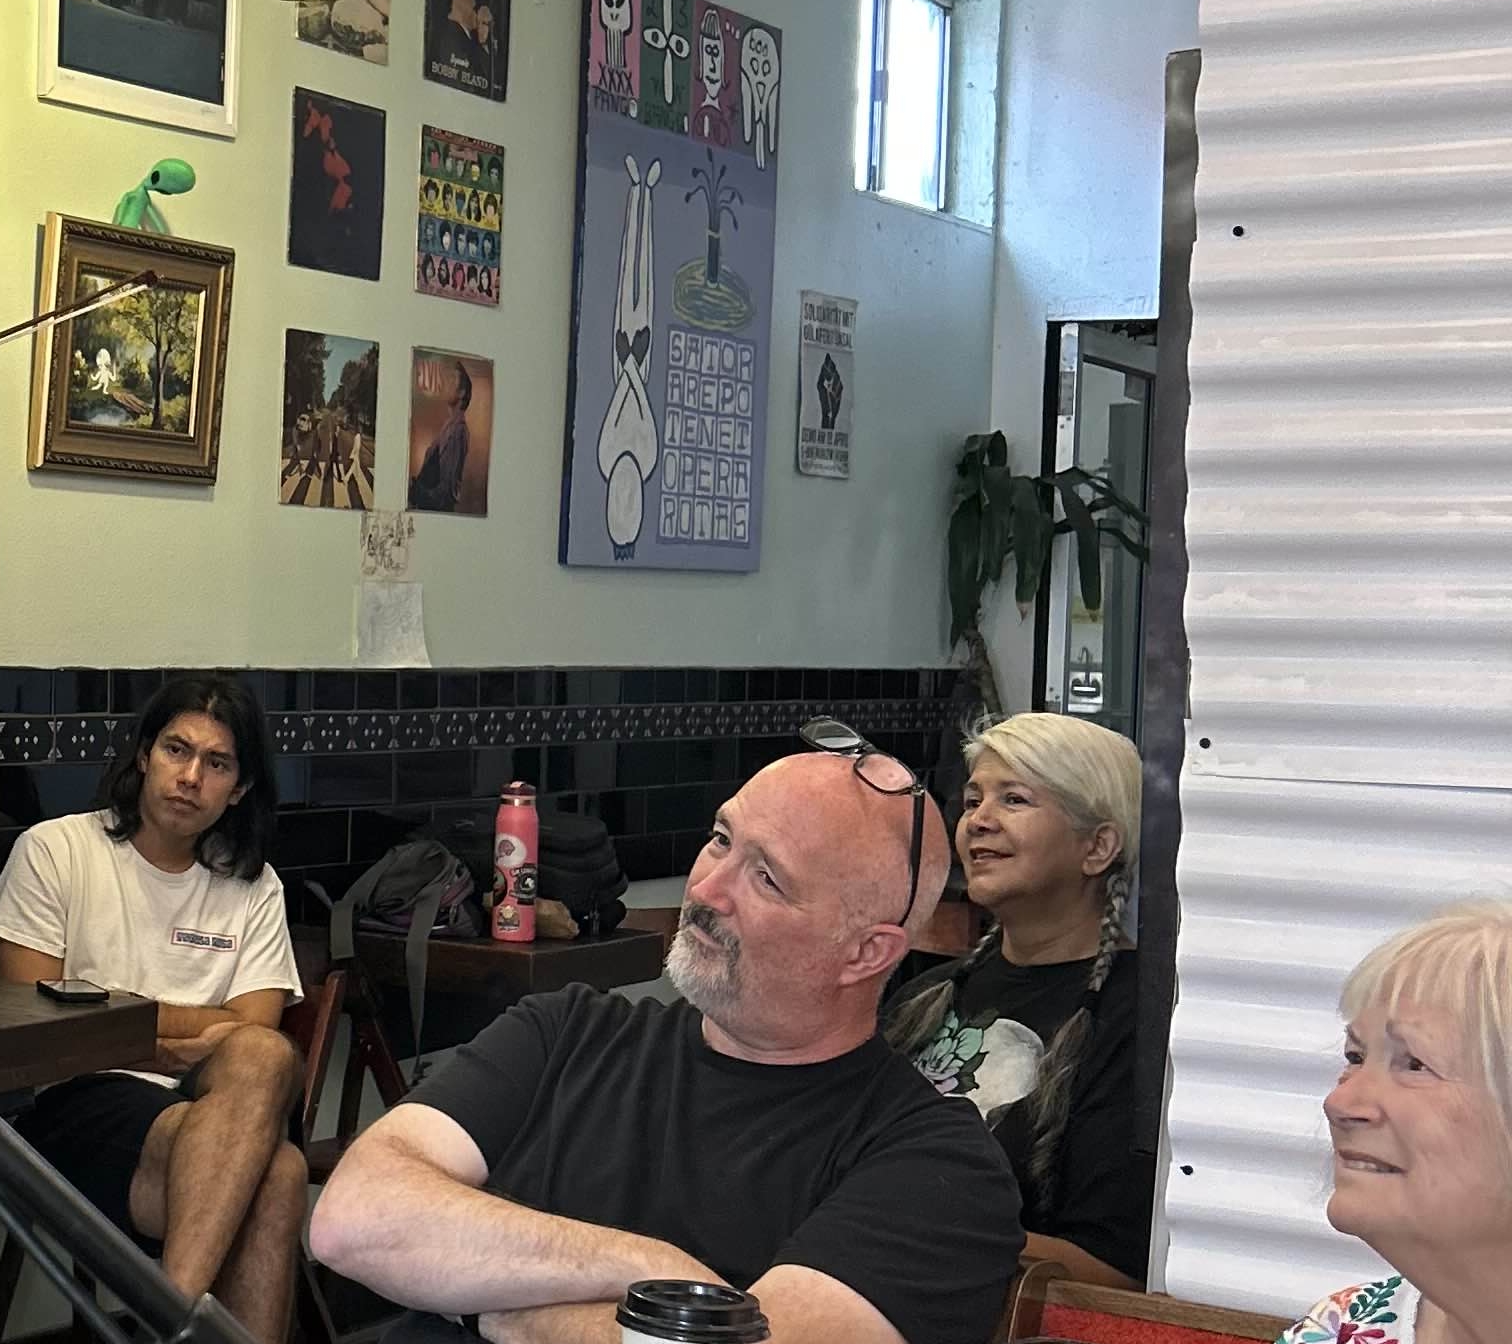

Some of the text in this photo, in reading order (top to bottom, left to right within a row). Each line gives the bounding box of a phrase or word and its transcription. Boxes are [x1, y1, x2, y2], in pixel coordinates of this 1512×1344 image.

[670, 333, 753, 380] SATOR
[668, 372, 751, 413] AREPO
[667, 409, 751, 450] TENET
[663, 451, 748, 495] OPERA
[662, 497, 747, 541] ROTAS
